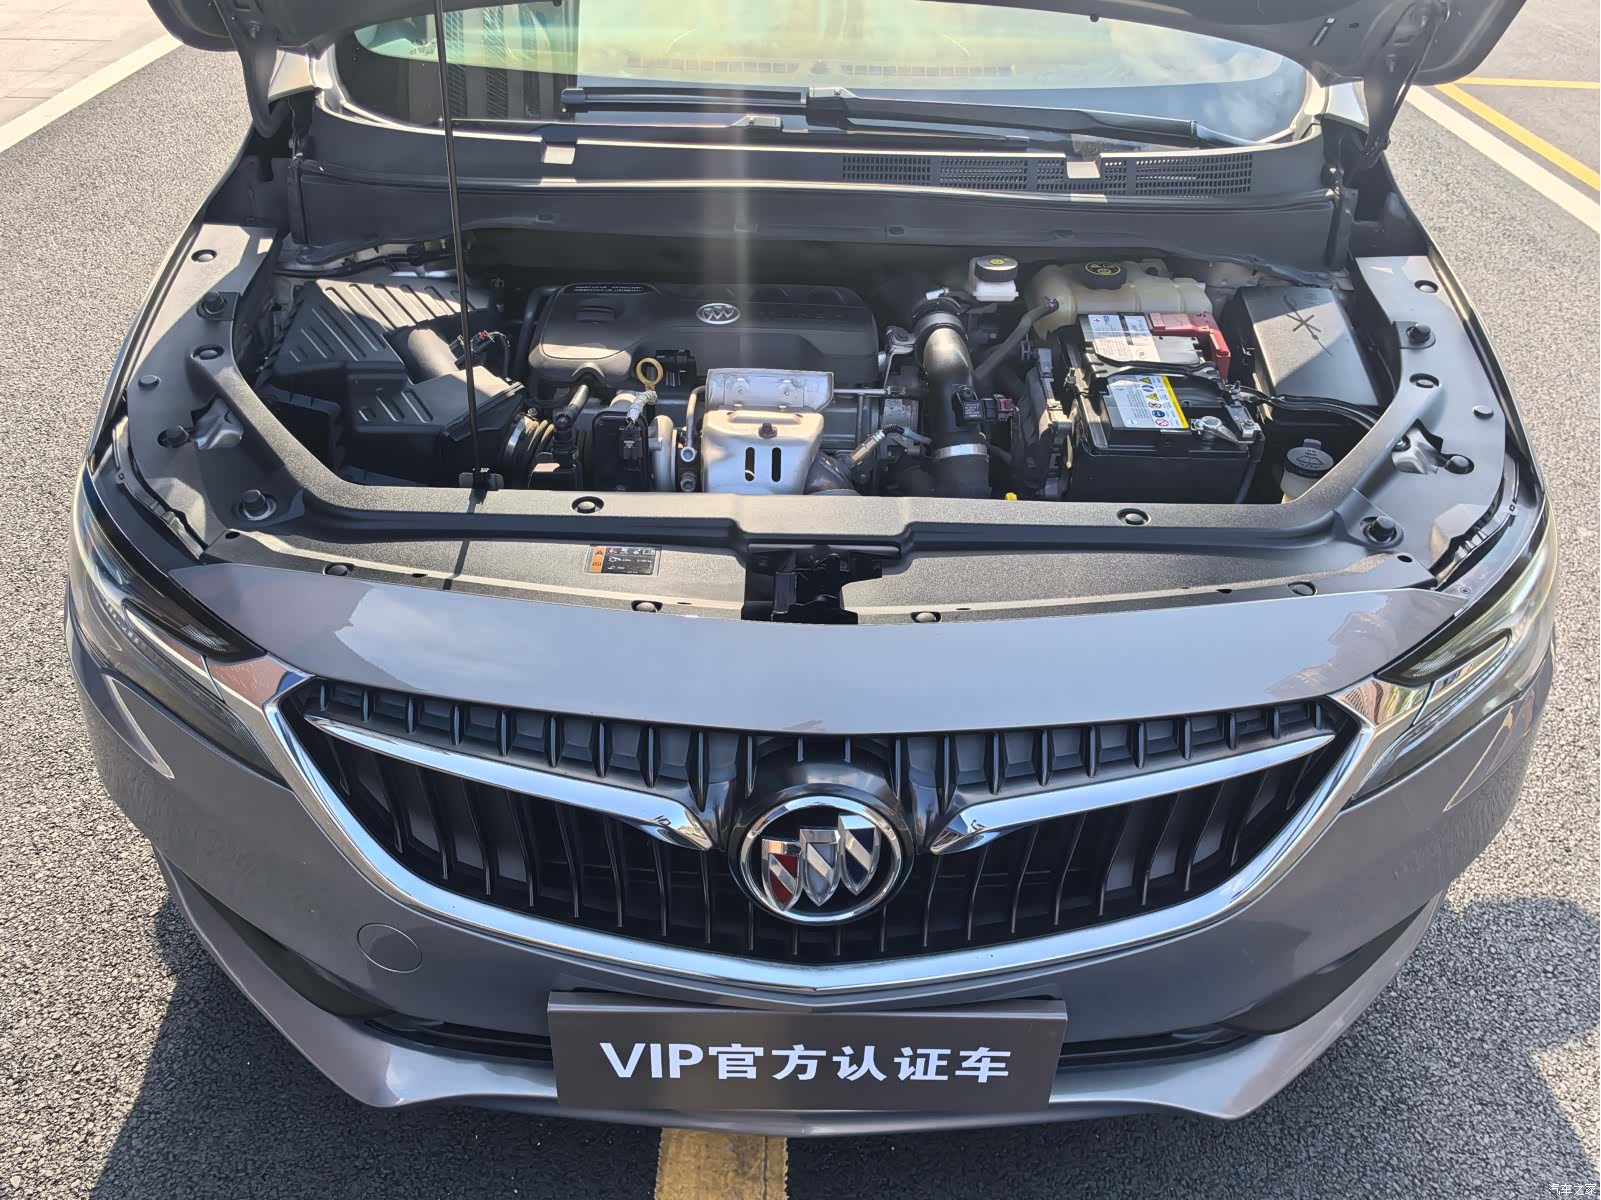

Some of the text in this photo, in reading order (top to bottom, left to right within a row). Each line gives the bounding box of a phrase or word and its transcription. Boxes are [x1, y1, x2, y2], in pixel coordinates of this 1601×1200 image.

[600, 1042, 1012, 1083] VIP官方认证车
